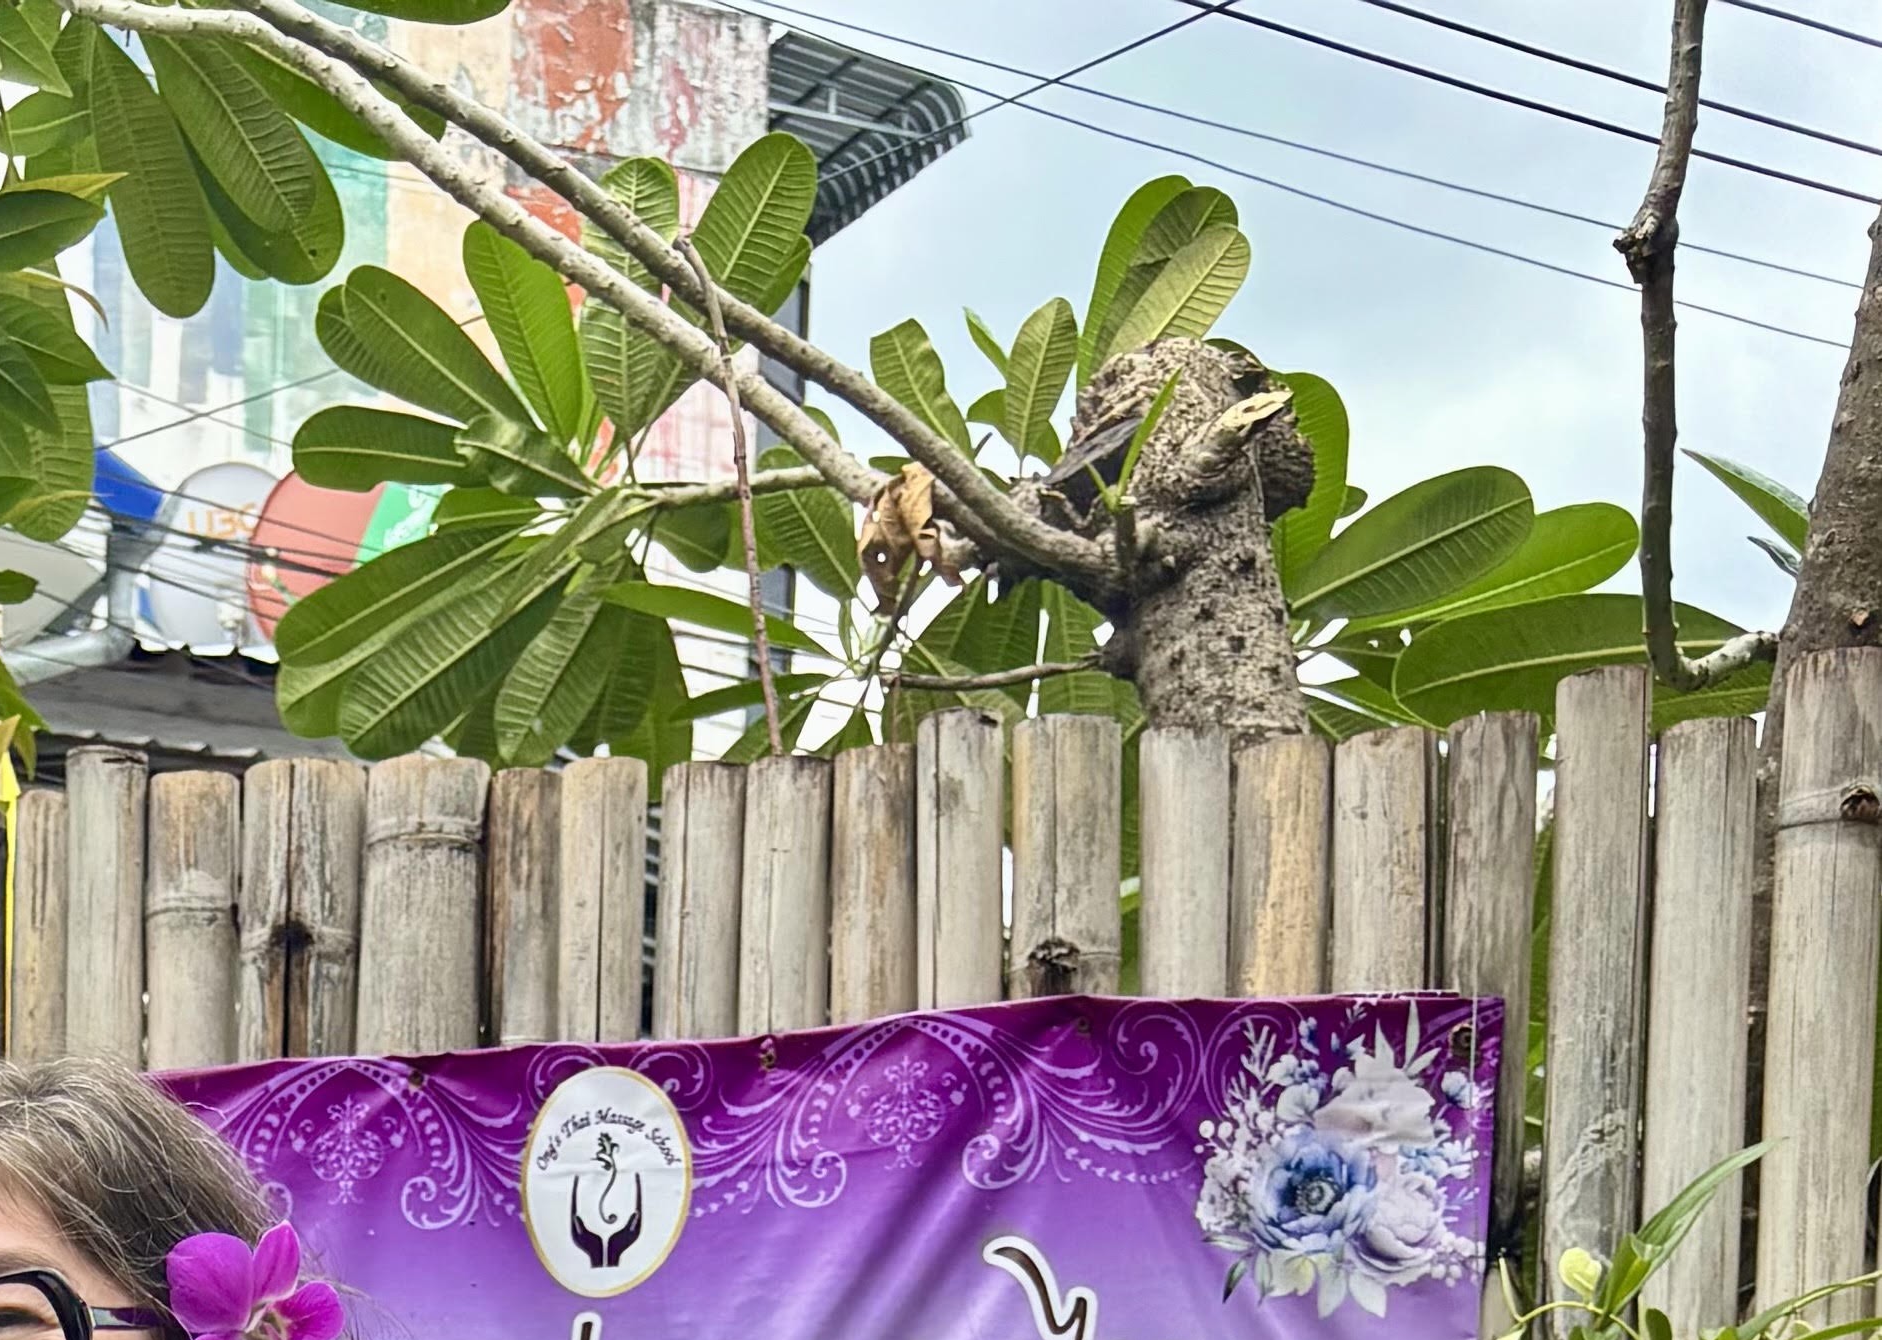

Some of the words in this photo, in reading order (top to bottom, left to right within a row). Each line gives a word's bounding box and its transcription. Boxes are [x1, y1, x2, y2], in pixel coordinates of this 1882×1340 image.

[536, 1135, 562, 1171] Ong's
[561, 1111, 591, 1138] Thai
[644, 1127, 682, 1166] School
